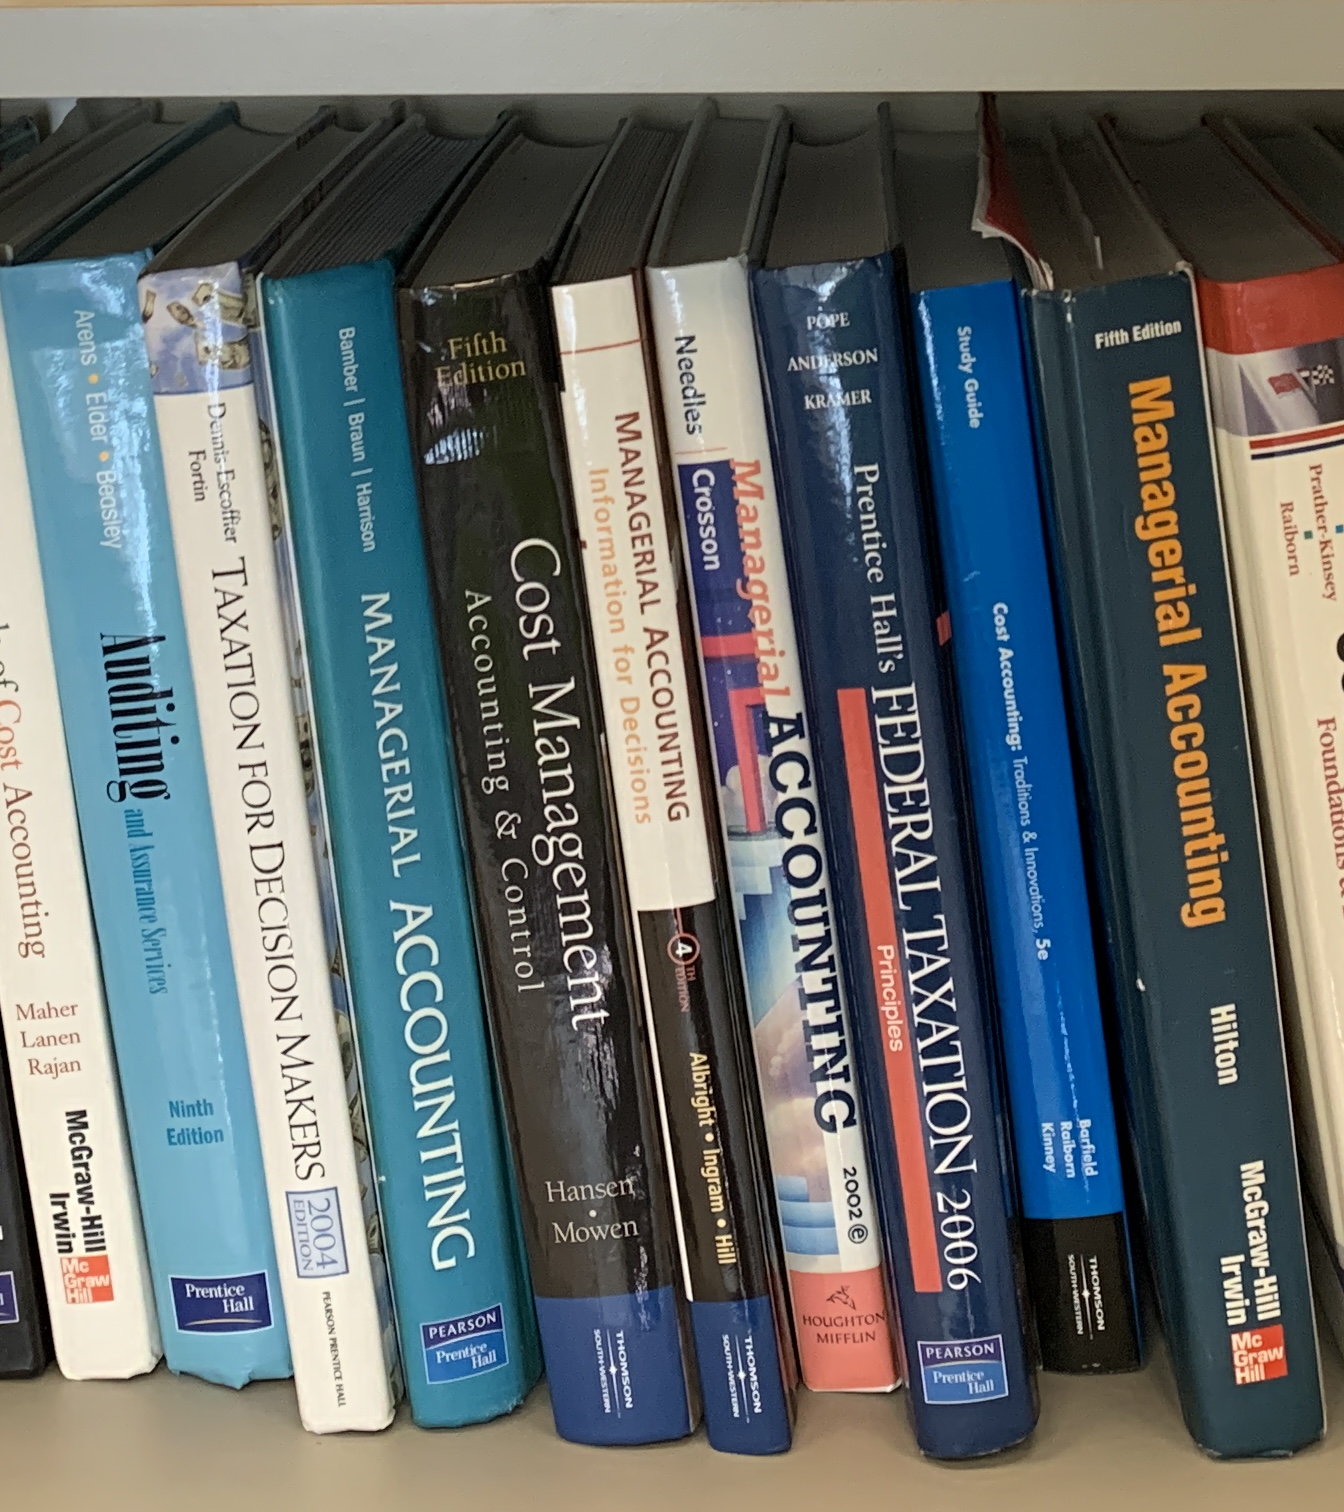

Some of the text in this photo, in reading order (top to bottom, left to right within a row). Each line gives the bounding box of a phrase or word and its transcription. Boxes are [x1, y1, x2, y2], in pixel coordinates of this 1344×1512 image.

[807, 312, 850, 329] POPE
[1095, 320, 1182, 349] Fifth Edition
[786, 347, 878, 372] ANDERSON
[855, 462, 897, 673] Prentice Hall's
[614, 410, 691, 822] MANAGERIAL ACCOUNTING
[2, 782, 45, 959] Accounting
[211, 556, 326, 1182] TAXATION FOR DECISION MAKERS
[361, 591, 476, 1272] MANAGERIAL ACCOUNTING
[871, 684, 982, 1292] FEDERAL TAXATION 2006
[877, 945, 904, 1052] Principles
[16, 1000, 78, 1022] Maher
[20, 1029, 81, 1049] Lanen
[1209, 1004, 1239, 1086] Hilton
[28, 1056, 82, 1077] Rajan
[168, 1100, 213, 1118] Ninth
[167, 1126, 224, 1146] Edition
[546, 1177, 633, 1202] Hansen
[553, 1217, 638, 1244] Mowen
